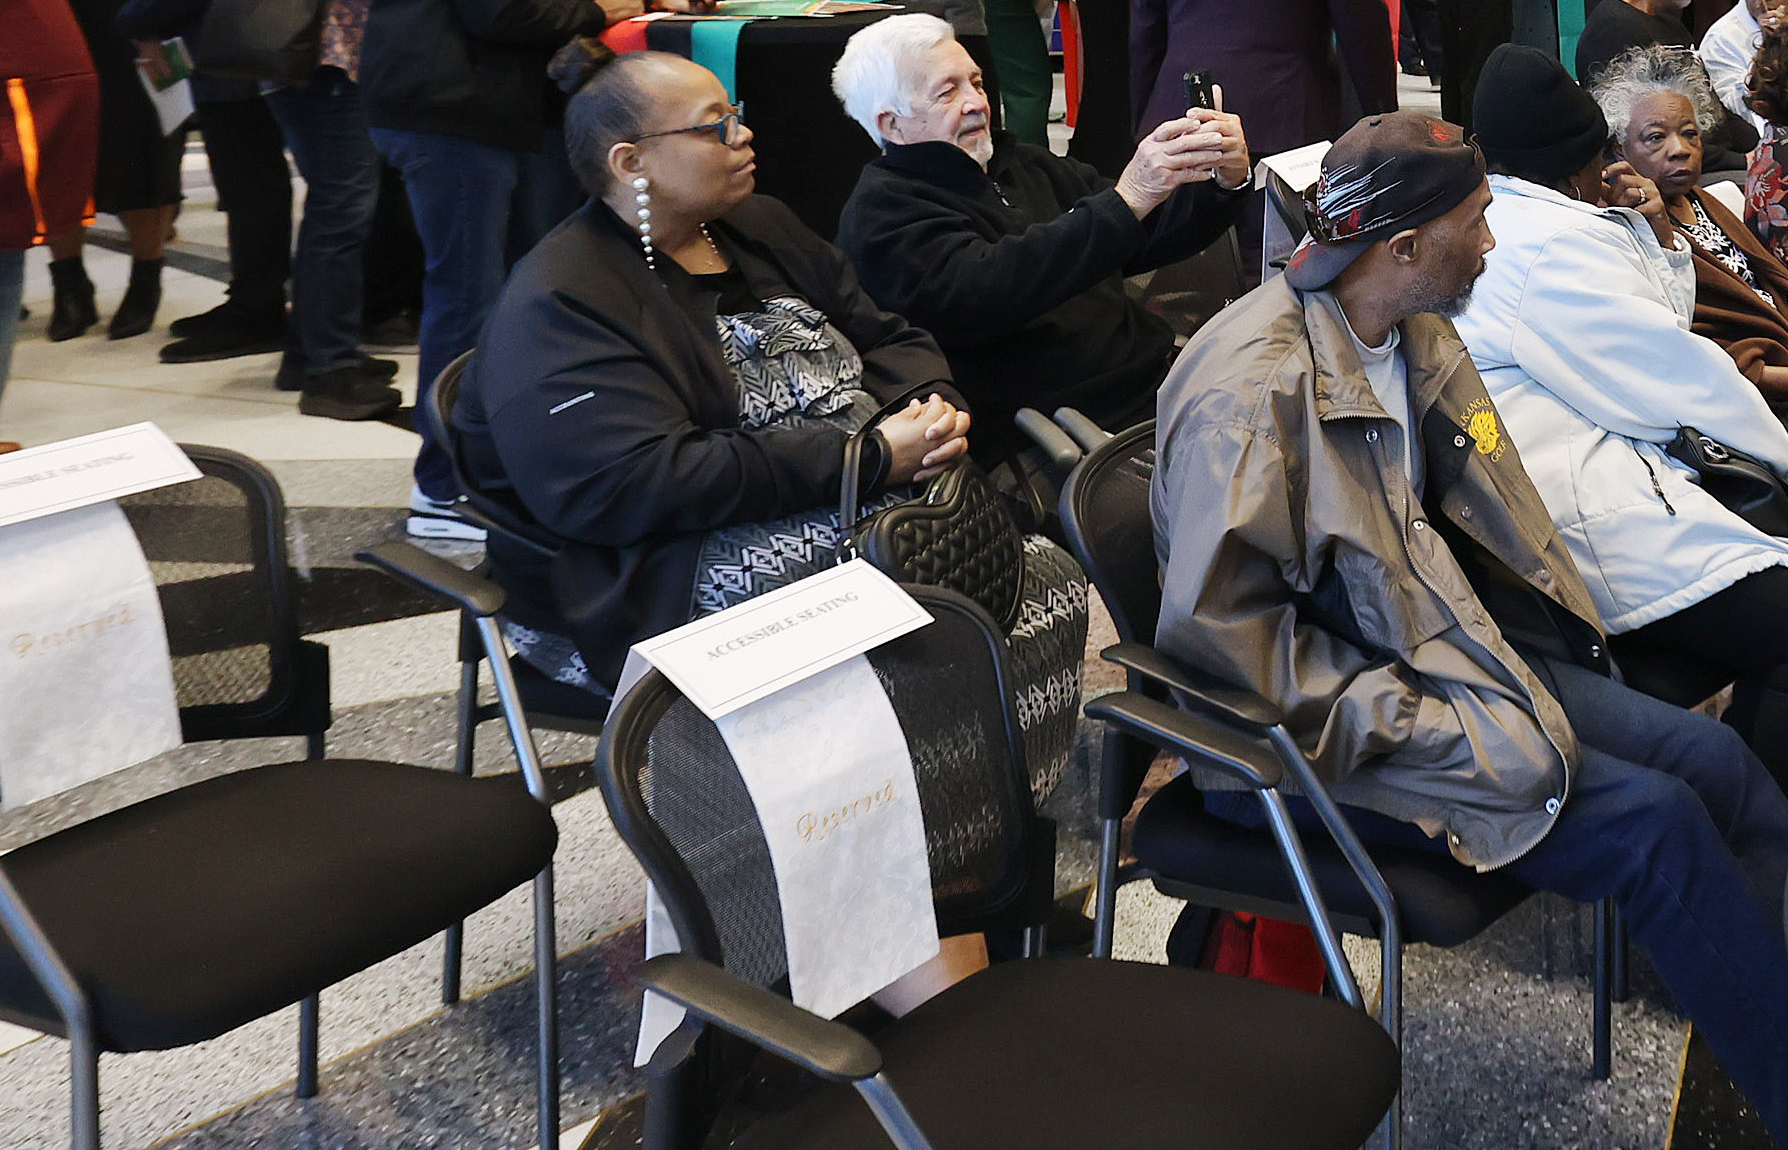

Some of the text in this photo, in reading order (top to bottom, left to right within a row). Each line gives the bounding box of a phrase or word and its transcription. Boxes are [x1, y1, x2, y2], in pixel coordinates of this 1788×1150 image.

[1490, 439, 1507, 462] GOLF
[706, 590, 859, 661] ACCESSIBLE SEATING
[797, 777, 897, 843] Reserved
